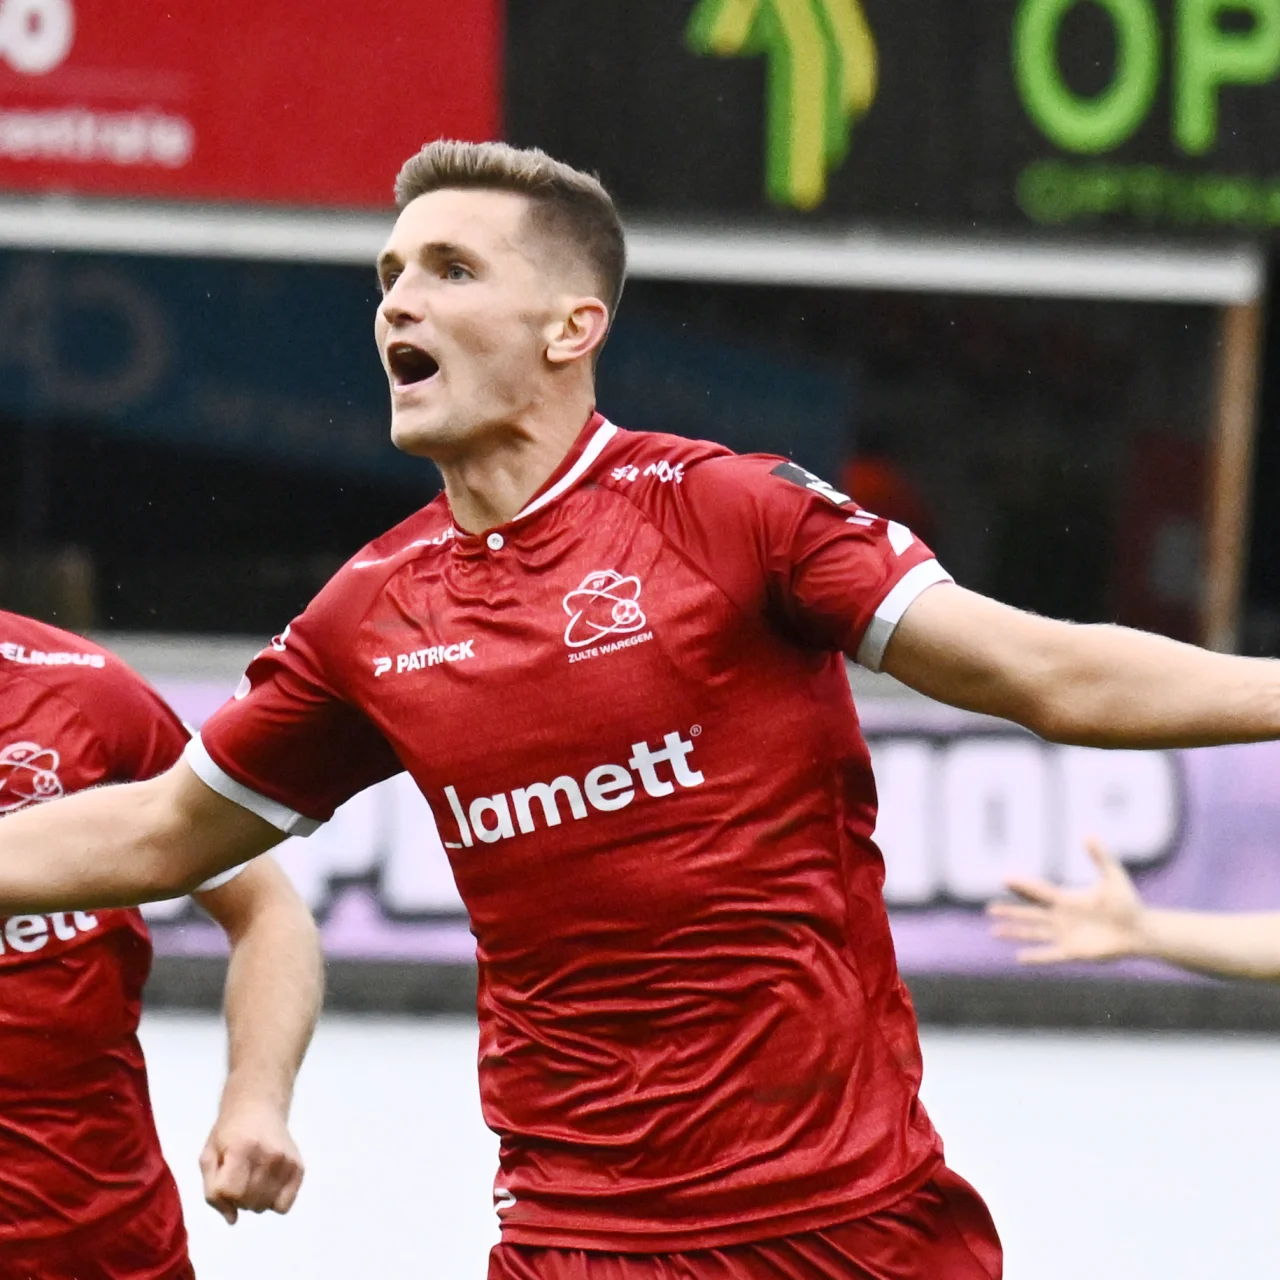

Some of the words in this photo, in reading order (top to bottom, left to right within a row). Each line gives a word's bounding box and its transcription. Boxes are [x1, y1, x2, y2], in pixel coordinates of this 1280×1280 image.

[396, 640, 475, 674] PATRICK
[567, 647, 599, 664] ZULTE
[599, 630, 654, 656] WAREGEM
